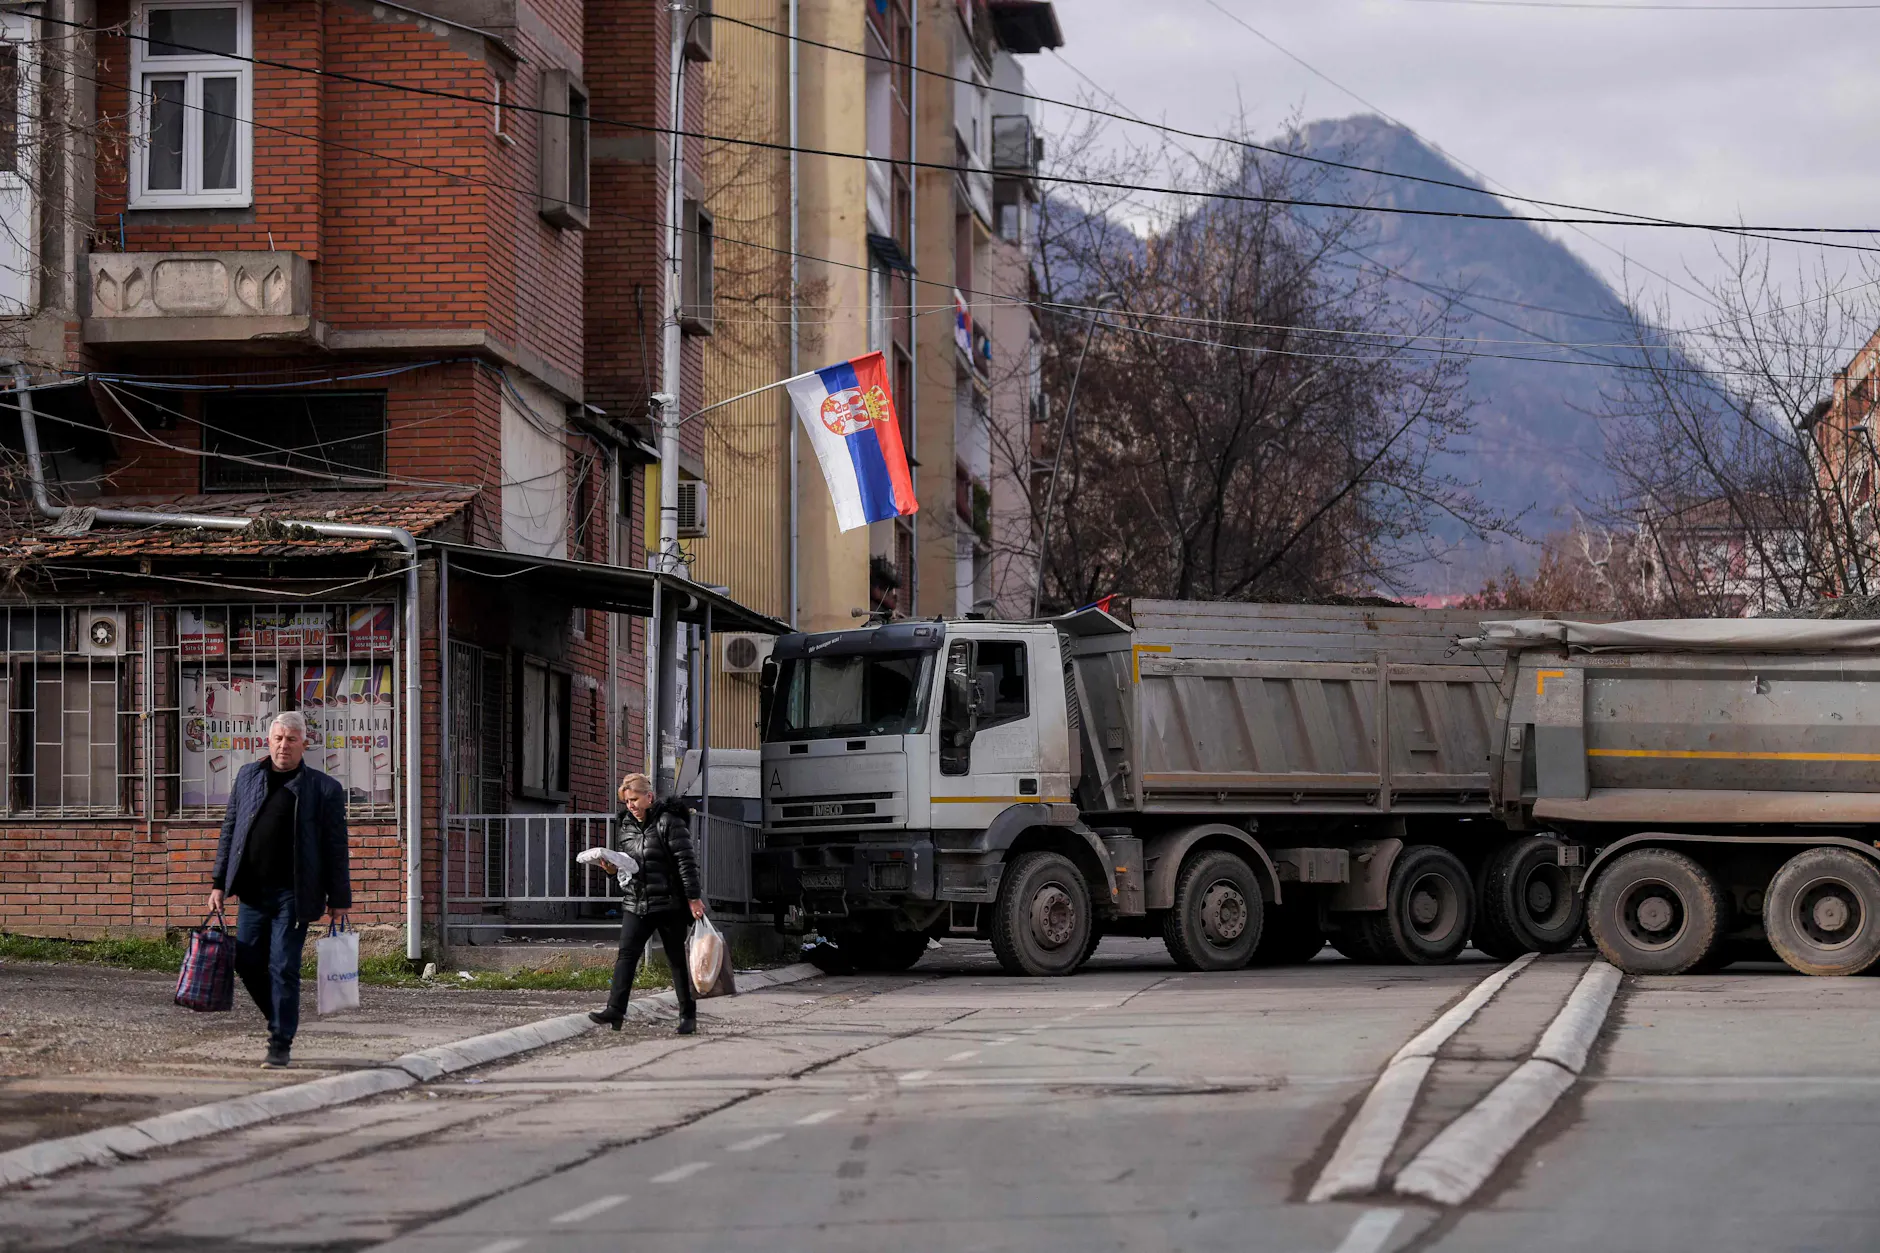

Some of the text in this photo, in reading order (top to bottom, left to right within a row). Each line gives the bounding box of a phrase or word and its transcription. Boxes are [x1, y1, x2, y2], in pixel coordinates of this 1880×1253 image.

[243, 628, 329, 645] MEDIUM
[769, 767, 783, 792] A
[813, 804, 843, 816] IVECO
